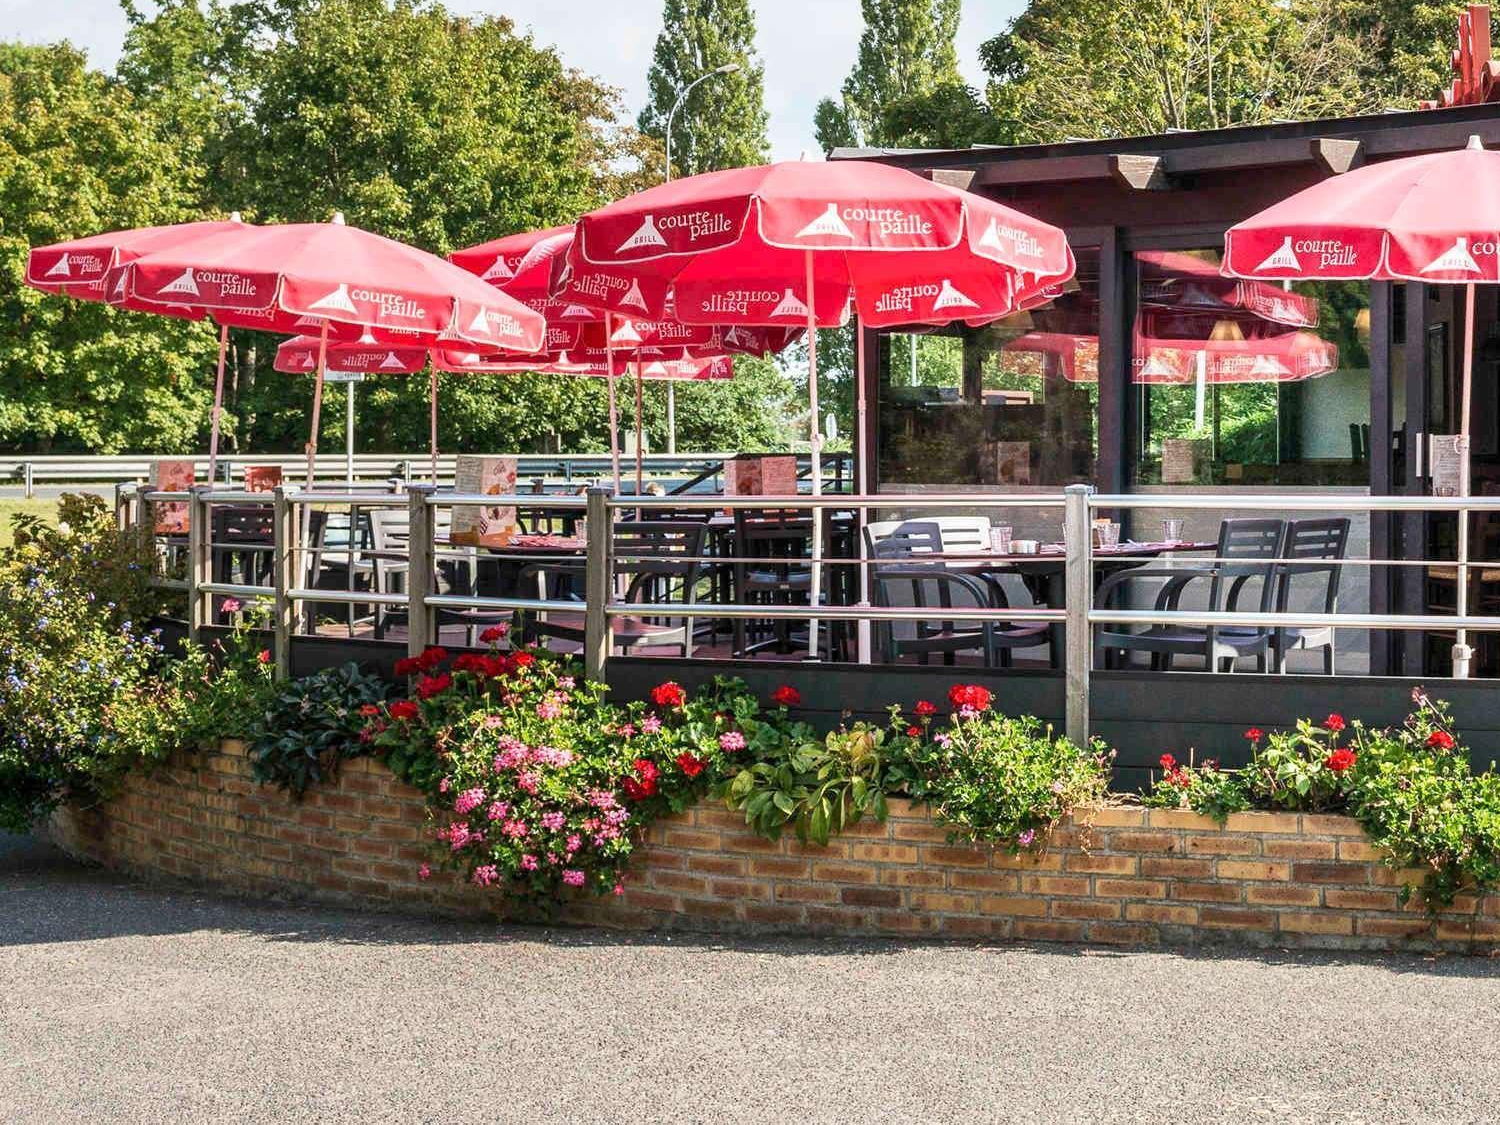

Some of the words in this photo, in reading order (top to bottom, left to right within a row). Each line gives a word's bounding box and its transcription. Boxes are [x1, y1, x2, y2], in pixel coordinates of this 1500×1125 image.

[659, 211, 710, 230] courte
[843, 208, 904, 222] courte
[690, 213, 732, 241] paille
[880, 214, 932, 238] paille
[998, 225, 1028, 239] courte
[1015, 237, 1045, 258] paille
[1295, 240, 1342, 253] courte
[1272, 257, 1292, 265] GRILL
[1318, 245, 1358, 269] paille
[196, 271, 240, 283] courte
[220, 278, 257, 296] paille
[352, 289, 403, 305] courte
[381, 299, 425, 319] paille
[634, 322, 675, 331] courte
[659, 324, 693, 339] paille
